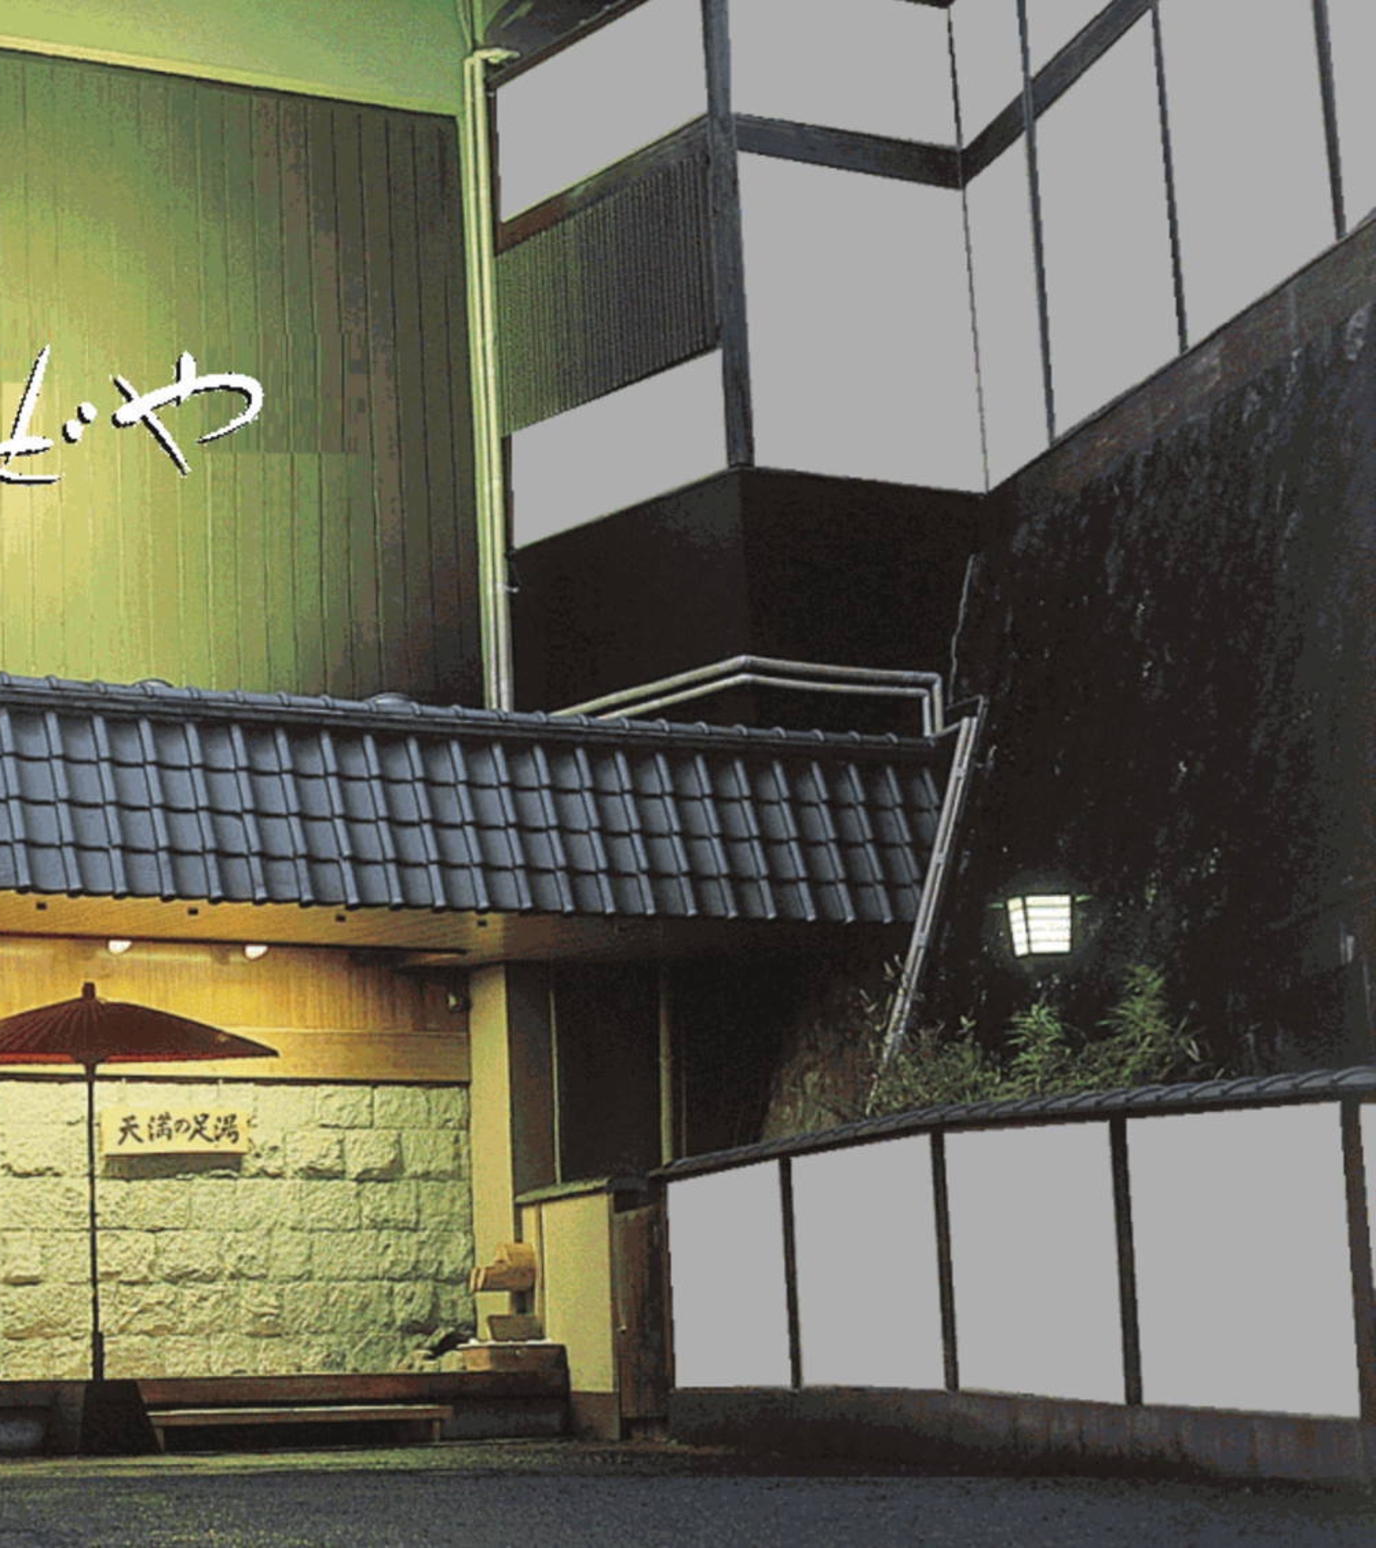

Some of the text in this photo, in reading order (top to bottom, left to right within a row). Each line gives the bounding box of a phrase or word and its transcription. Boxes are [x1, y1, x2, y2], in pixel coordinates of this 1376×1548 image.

[117, 1111, 240, 1146] 天満の足湯
